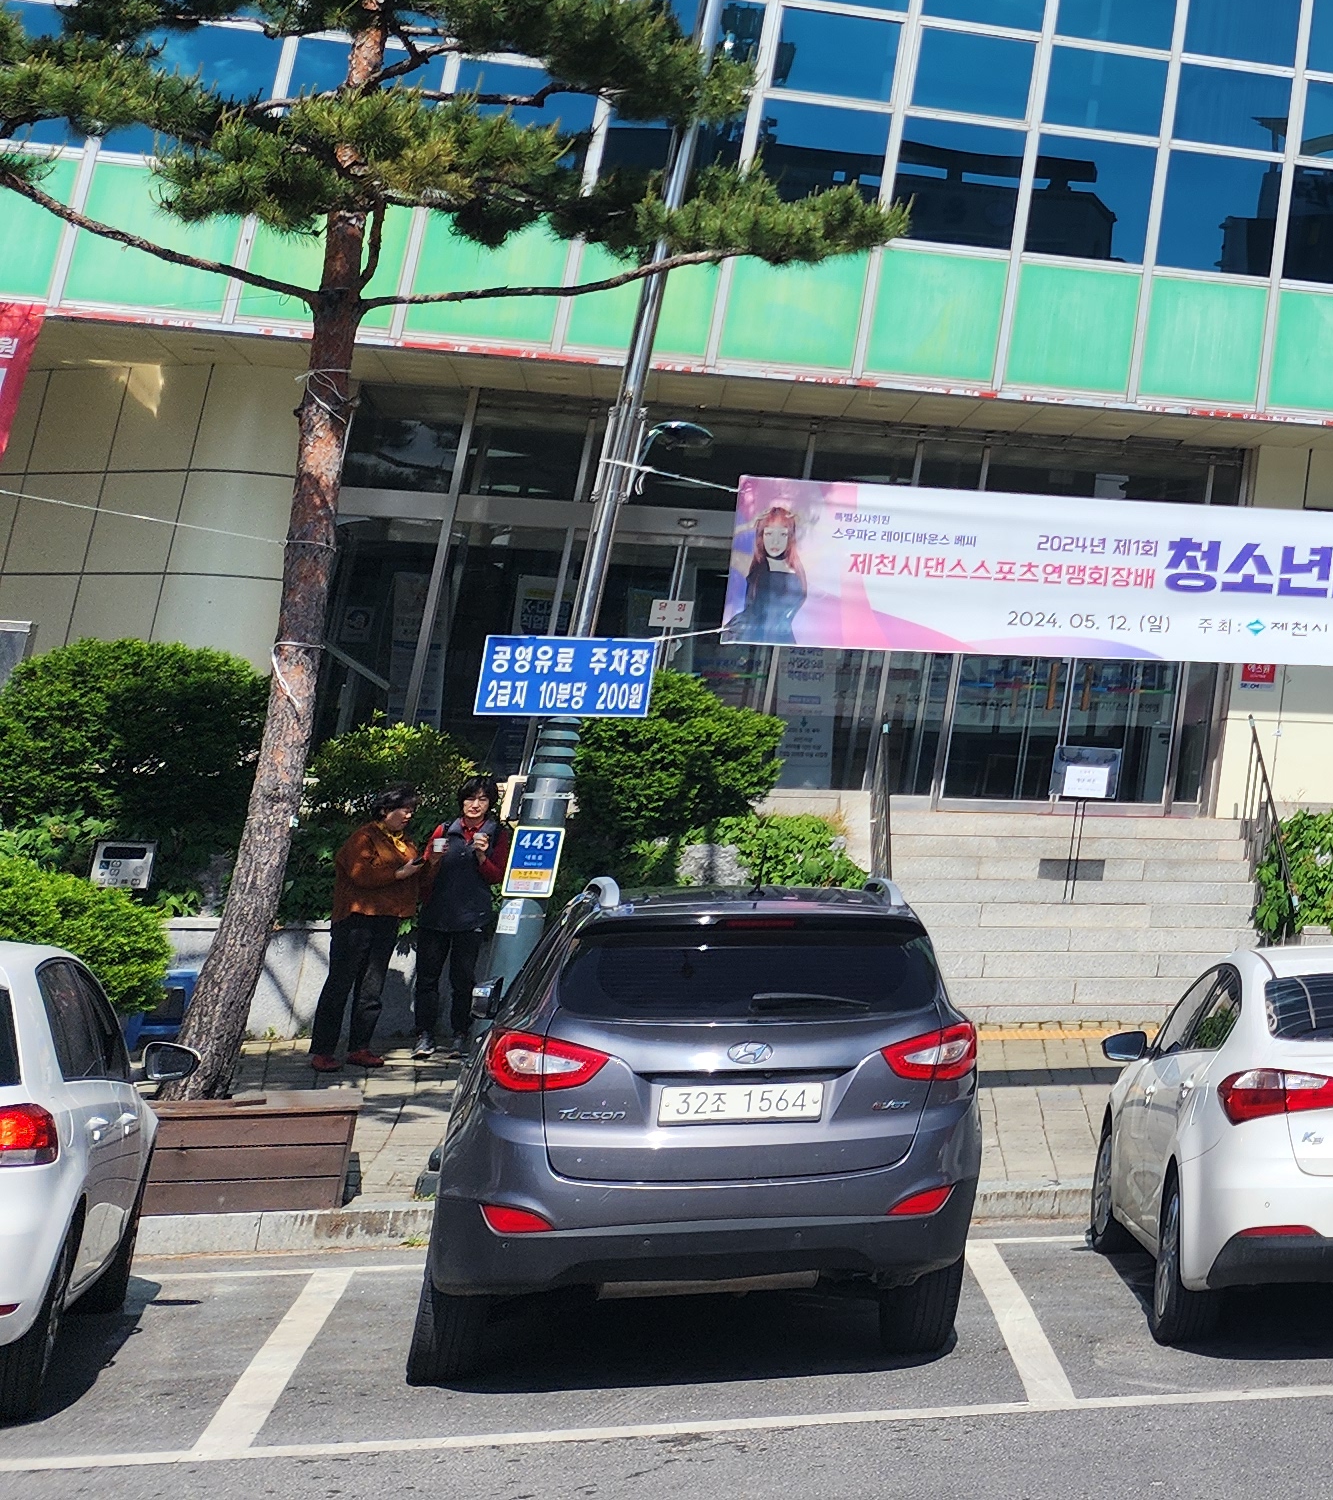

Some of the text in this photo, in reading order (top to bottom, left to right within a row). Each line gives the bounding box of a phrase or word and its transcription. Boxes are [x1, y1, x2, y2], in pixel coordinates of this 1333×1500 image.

[832, 528, 877, 542] 스우파2
[880, 530, 951, 546] 레이디바운스
[1037, 534, 1159, 558] 2024년 제1회
[847, 552, 1157, 590] 제천시댄스스포츠연맹회장배
[1007, 610, 1063, 629] 2024.
[1069, 613, 1100, 630] 05.
[1107, 615, 1132, 631] 12.
[1139, 614, 1171, 634] (일)
[1270, 621, 1329, 637] 제천시
[491, 645, 650, 678] 공영유료 주차장
[484, 680, 644, 710] 2급지 10분당 200원
[519, 832, 557, 850] 443
[675, 1088, 808, 1115] 32조 1564
